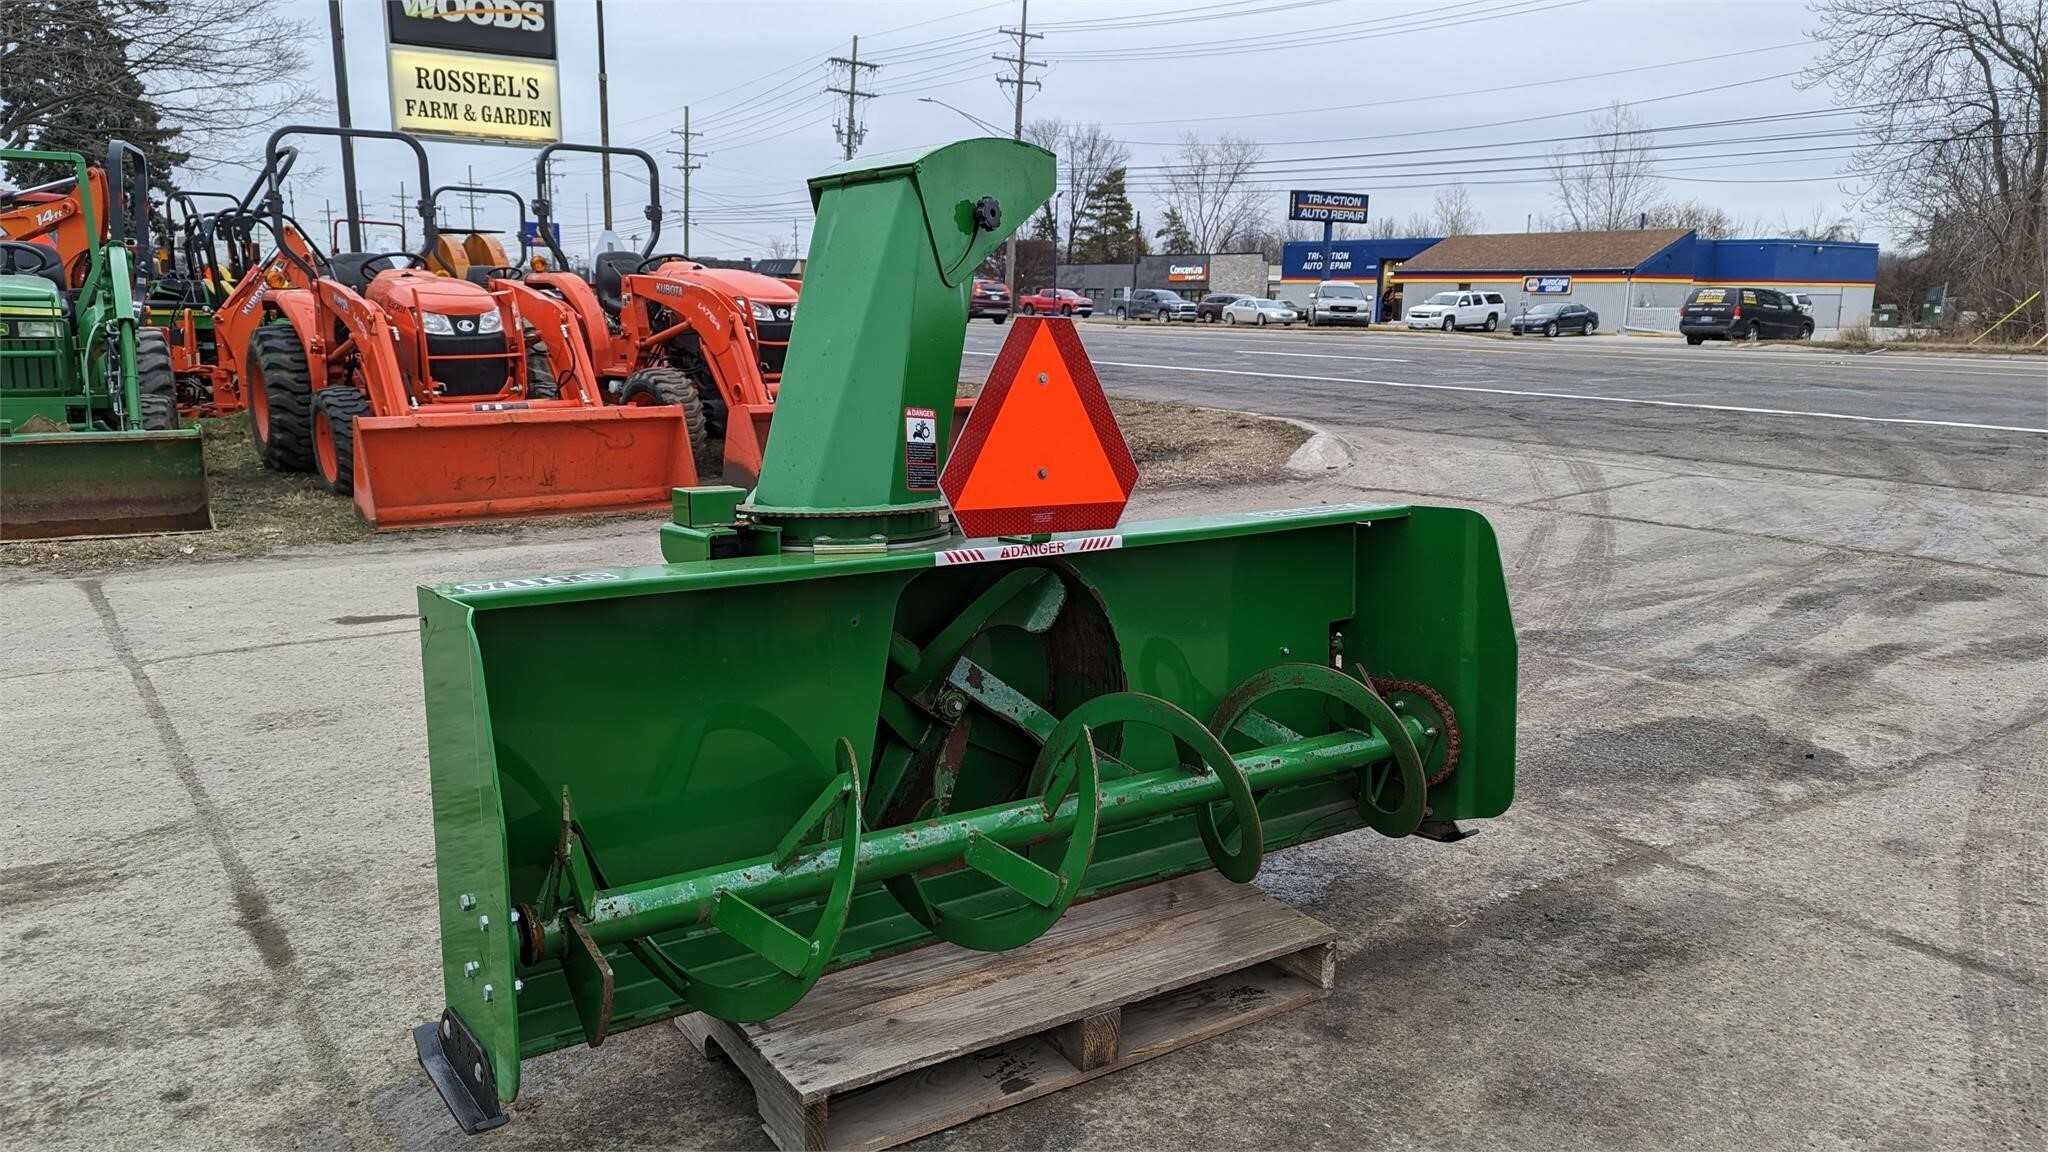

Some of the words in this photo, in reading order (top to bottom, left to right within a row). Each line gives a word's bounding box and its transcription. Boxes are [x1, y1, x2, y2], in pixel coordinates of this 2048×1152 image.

[402, 0, 545, 32] WOODS
[415, 66, 540, 100] ROSSEEL'S
[405, 98, 459, 121] FARM
[463, 103, 477, 122] &
[481, 105, 552, 128] GARDEN
[1300, 208, 1328, 219] AUTO
[1330, 211, 1365, 221] REPAIR
[1302, 261, 1323, 270] AUTO
[1329, 261, 1352, 270] EPAIR
[656, 283, 684, 297] KUBOTA
[911, 409, 935, 418] DANGER
[1011, 542, 1066, 557] DANGER
